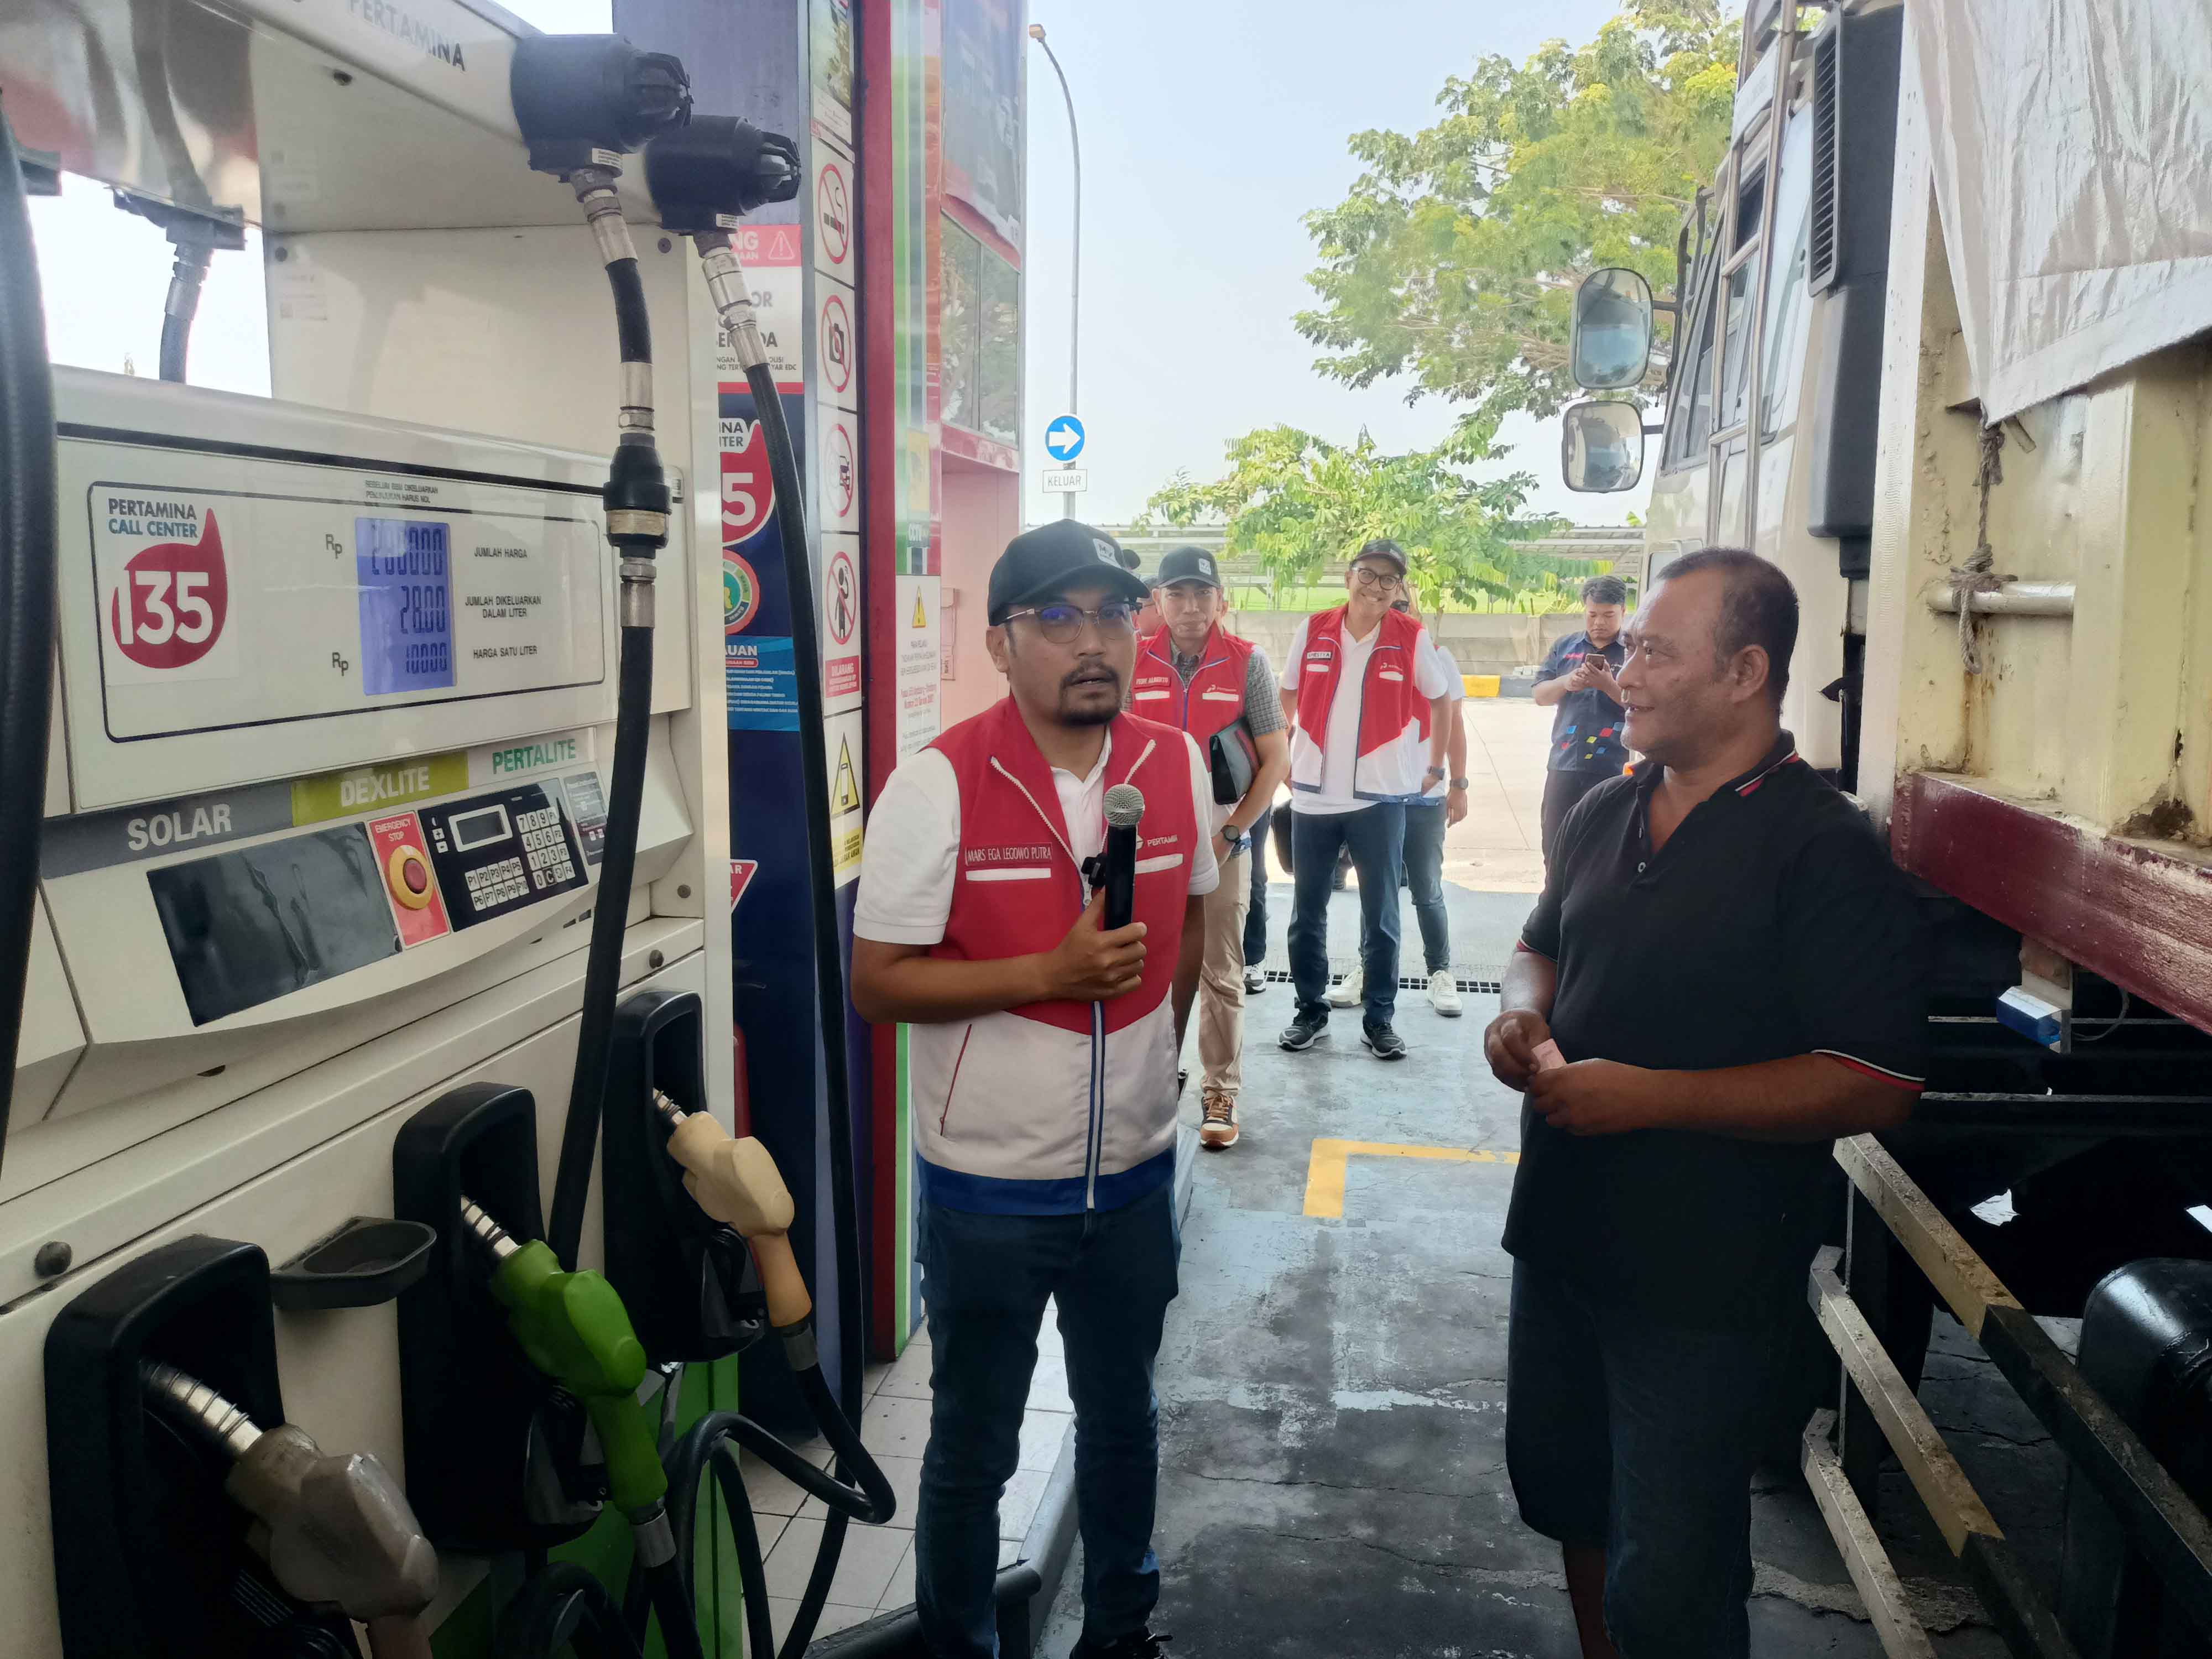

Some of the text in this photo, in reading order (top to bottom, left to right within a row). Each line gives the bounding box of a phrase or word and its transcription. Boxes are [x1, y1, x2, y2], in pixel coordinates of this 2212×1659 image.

[752, 291, 773, 308] OR
[1048, 475, 1081, 487] KELUAR
[108, 498, 197, 520] PERTAMINA
[108, 518, 198, 538] CALL CENTER
[474, 546, 528, 558] JUMLAH HARGA
[117, 570, 213, 645] 135
[465, 595, 541, 606] JUMLAH DIKELUARKAN
[483, 608, 527, 618] DALAM LITER
[473, 646, 538, 659] HARGA SATU LITER
[492, 739, 576, 774] PERTALITE
[340, 766, 430, 807] DEXLITE
[128, 804, 232, 851] SOLAR
[519, 818, 525, 830] 7
[530, 815, 536, 827] 8
[540, 812, 546, 823] 9
[389, 831, 404, 842] STOP
[526, 837, 532, 848] 4
[535, 834, 541, 846] 5
[545, 831, 552, 843] 6
[531, 855, 537, 867] 1
[540, 853, 547, 864] 2
[550, 849, 557, 861] 3
[968, 848, 986, 862] MARS
[1031, 846, 1051, 859] PUTRA
[467, 861, 521, 886] P1 P2 P3 P4 P5
[536, 874, 543, 886] 0
[546, 870, 554, 884] C
[473, 895, 483, 906] P6
[485, 891, 494, 902] P7
[496, 888, 505, 899] P8
[507, 884, 516, 895] P9
